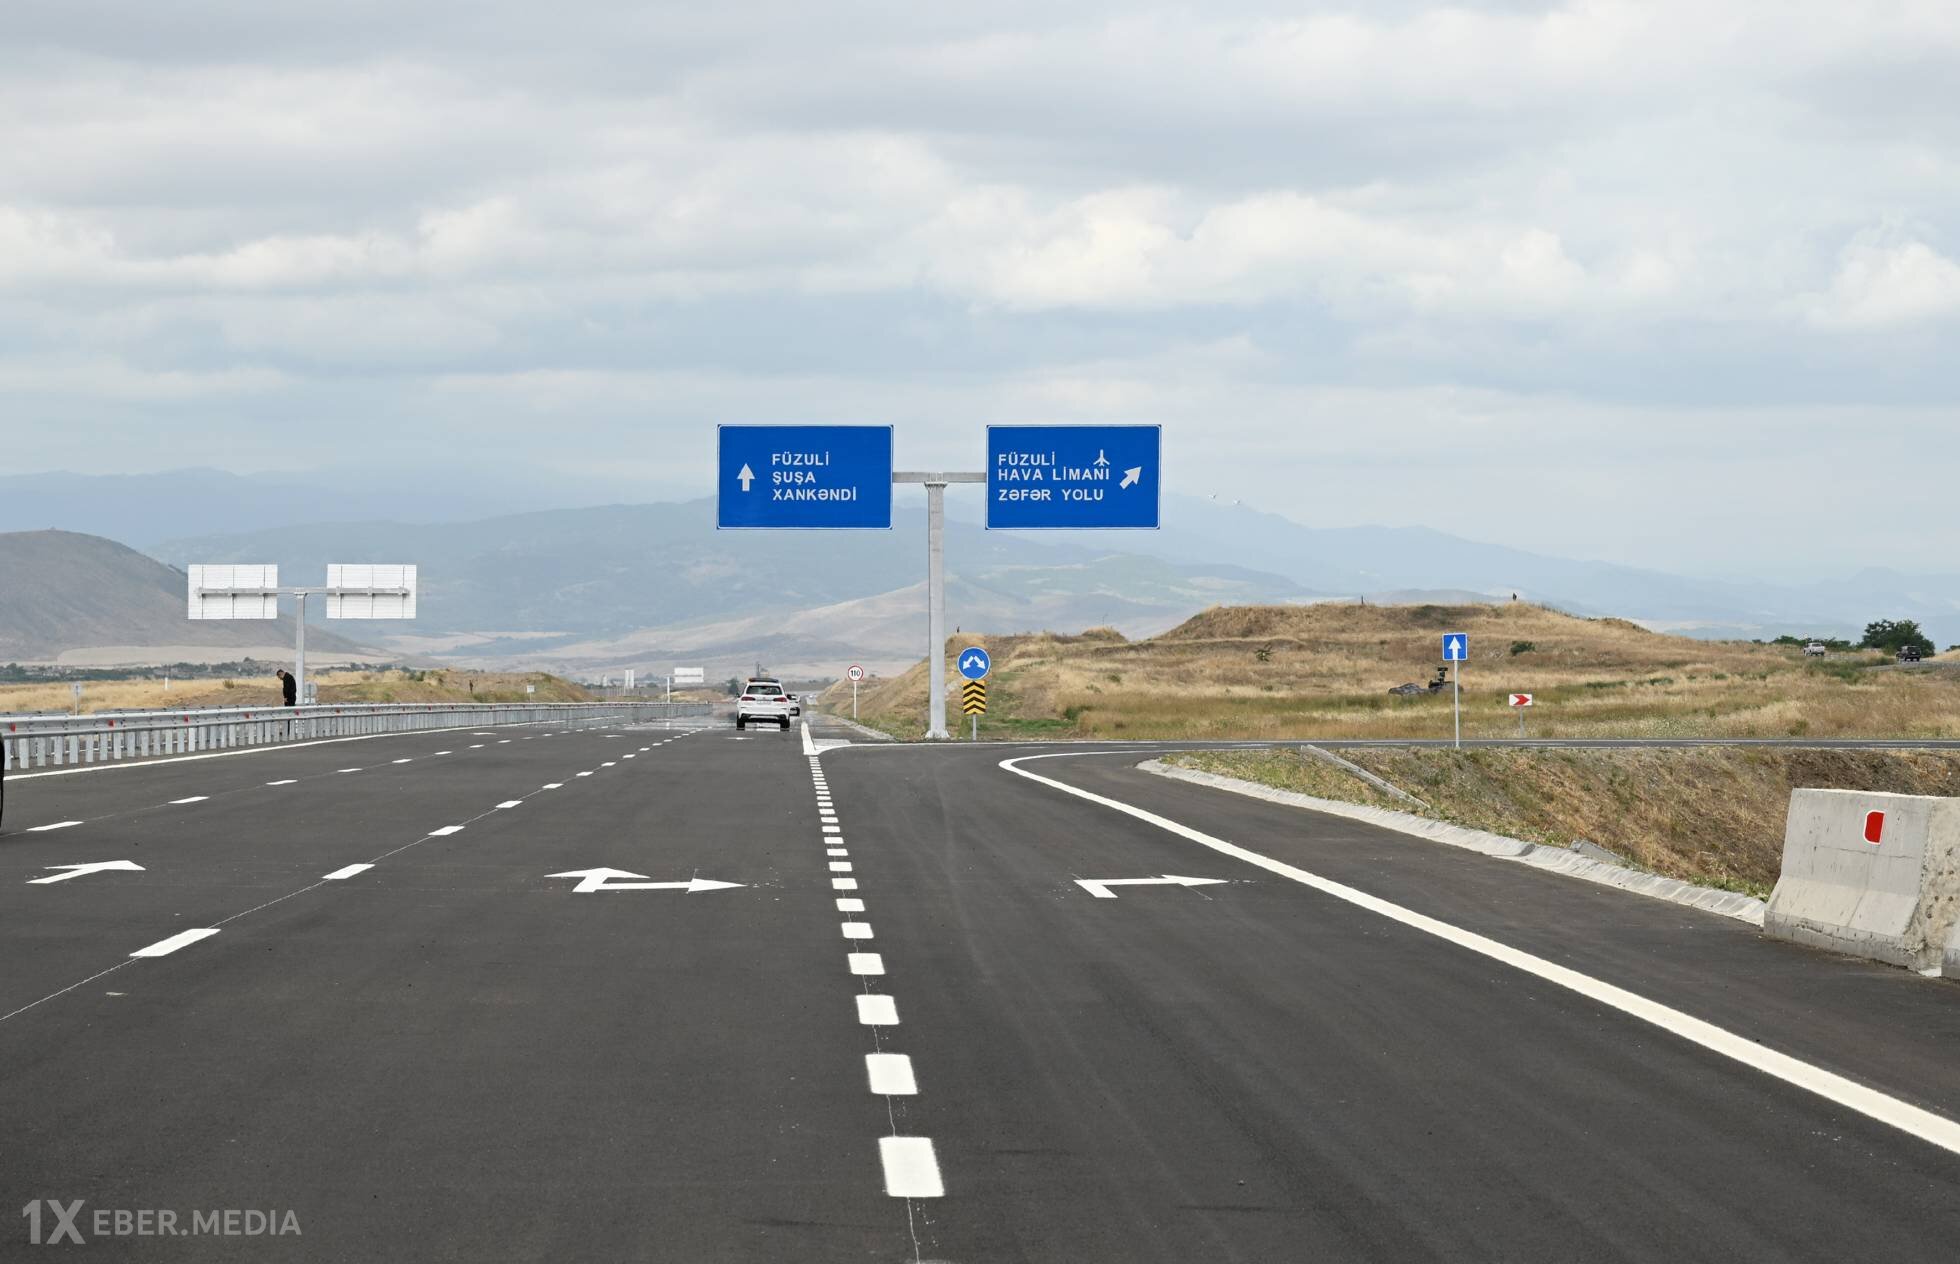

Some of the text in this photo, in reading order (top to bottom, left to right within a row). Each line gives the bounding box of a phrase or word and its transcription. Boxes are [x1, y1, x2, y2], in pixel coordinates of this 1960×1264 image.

[772, 451, 829, 466] FÜZULİ
[998, 451, 1055, 466] FÜZULİ
[772, 471, 816, 485] ŞUŞA
[998, 466, 1110, 481] HAVA LİMANI
[772, 486, 857, 501] XANKƏNDİ
[998, 488, 1104, 501] ZƏFƏR YOLU
